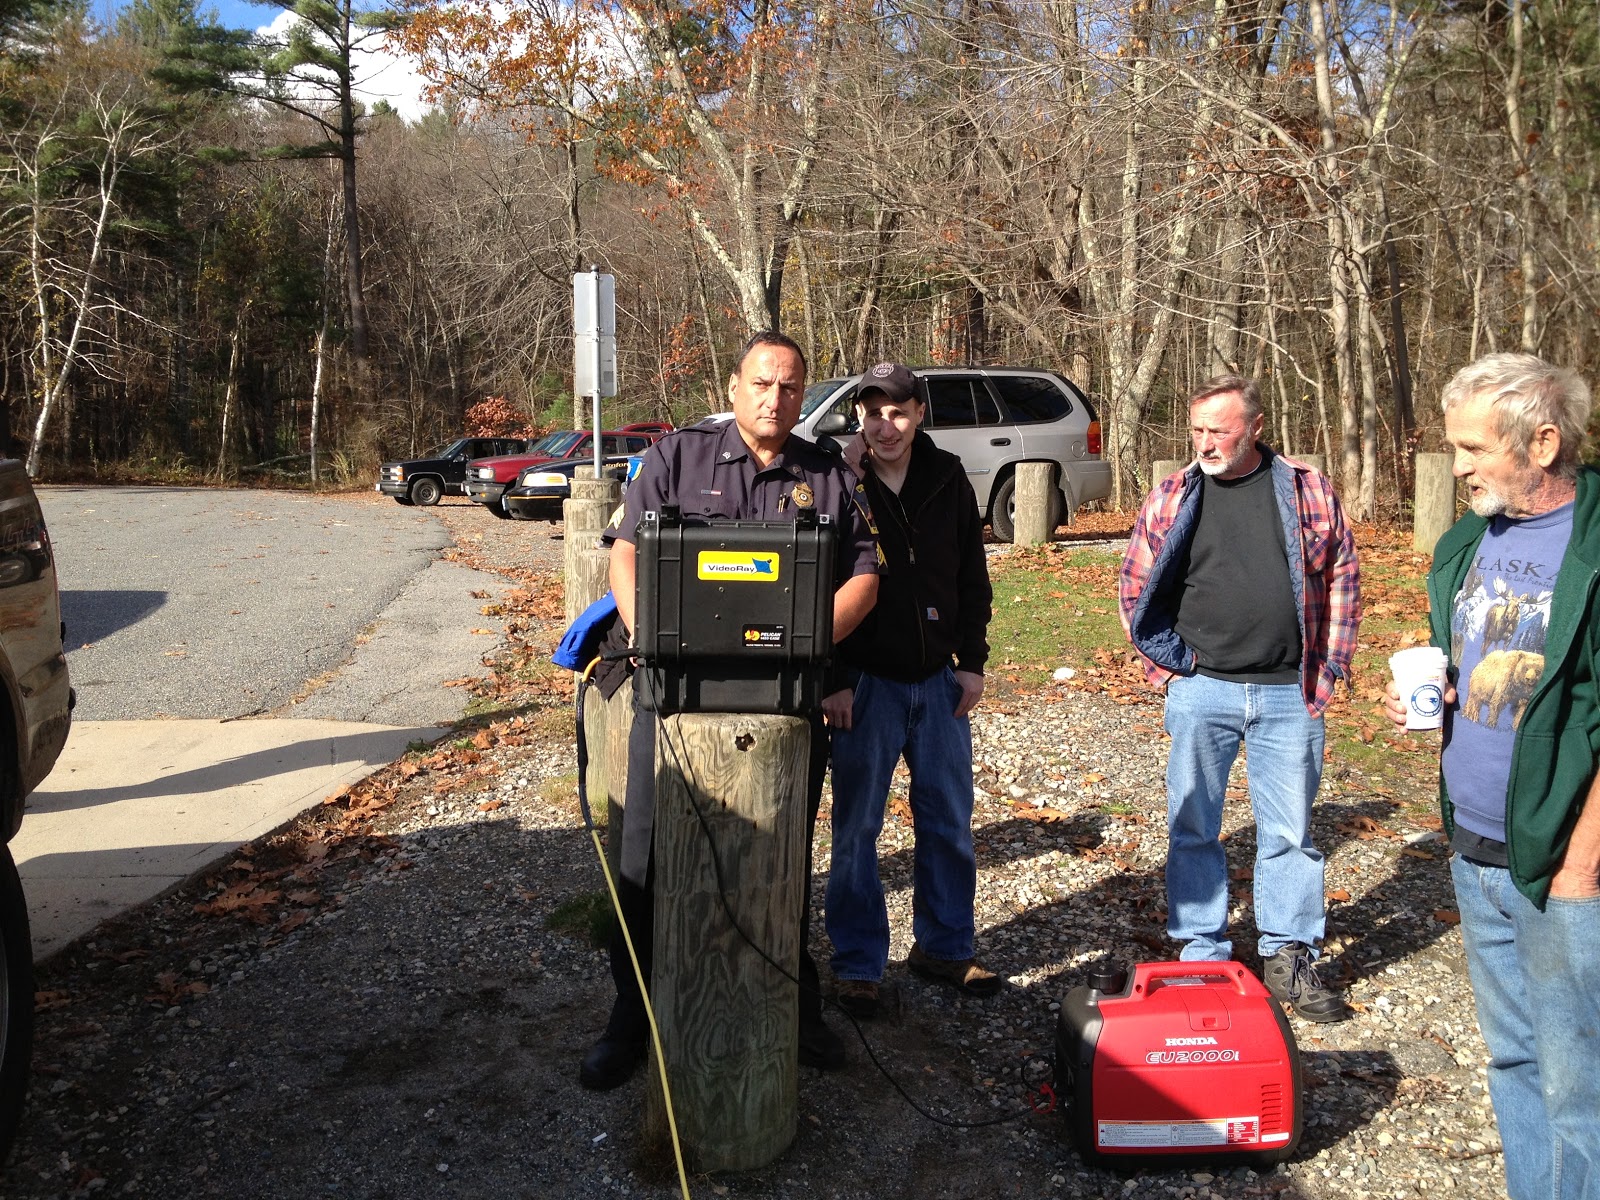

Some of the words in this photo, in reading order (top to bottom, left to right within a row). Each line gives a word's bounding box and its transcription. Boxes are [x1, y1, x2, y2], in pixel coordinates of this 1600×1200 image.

[708, 564, 755, 572] VideoRay
[1476, 556, 1559, 581] LASK
[1165, 1037, 1218, 1046] HONDA
[1145, 1049, 1240, 1064] EU2000i
